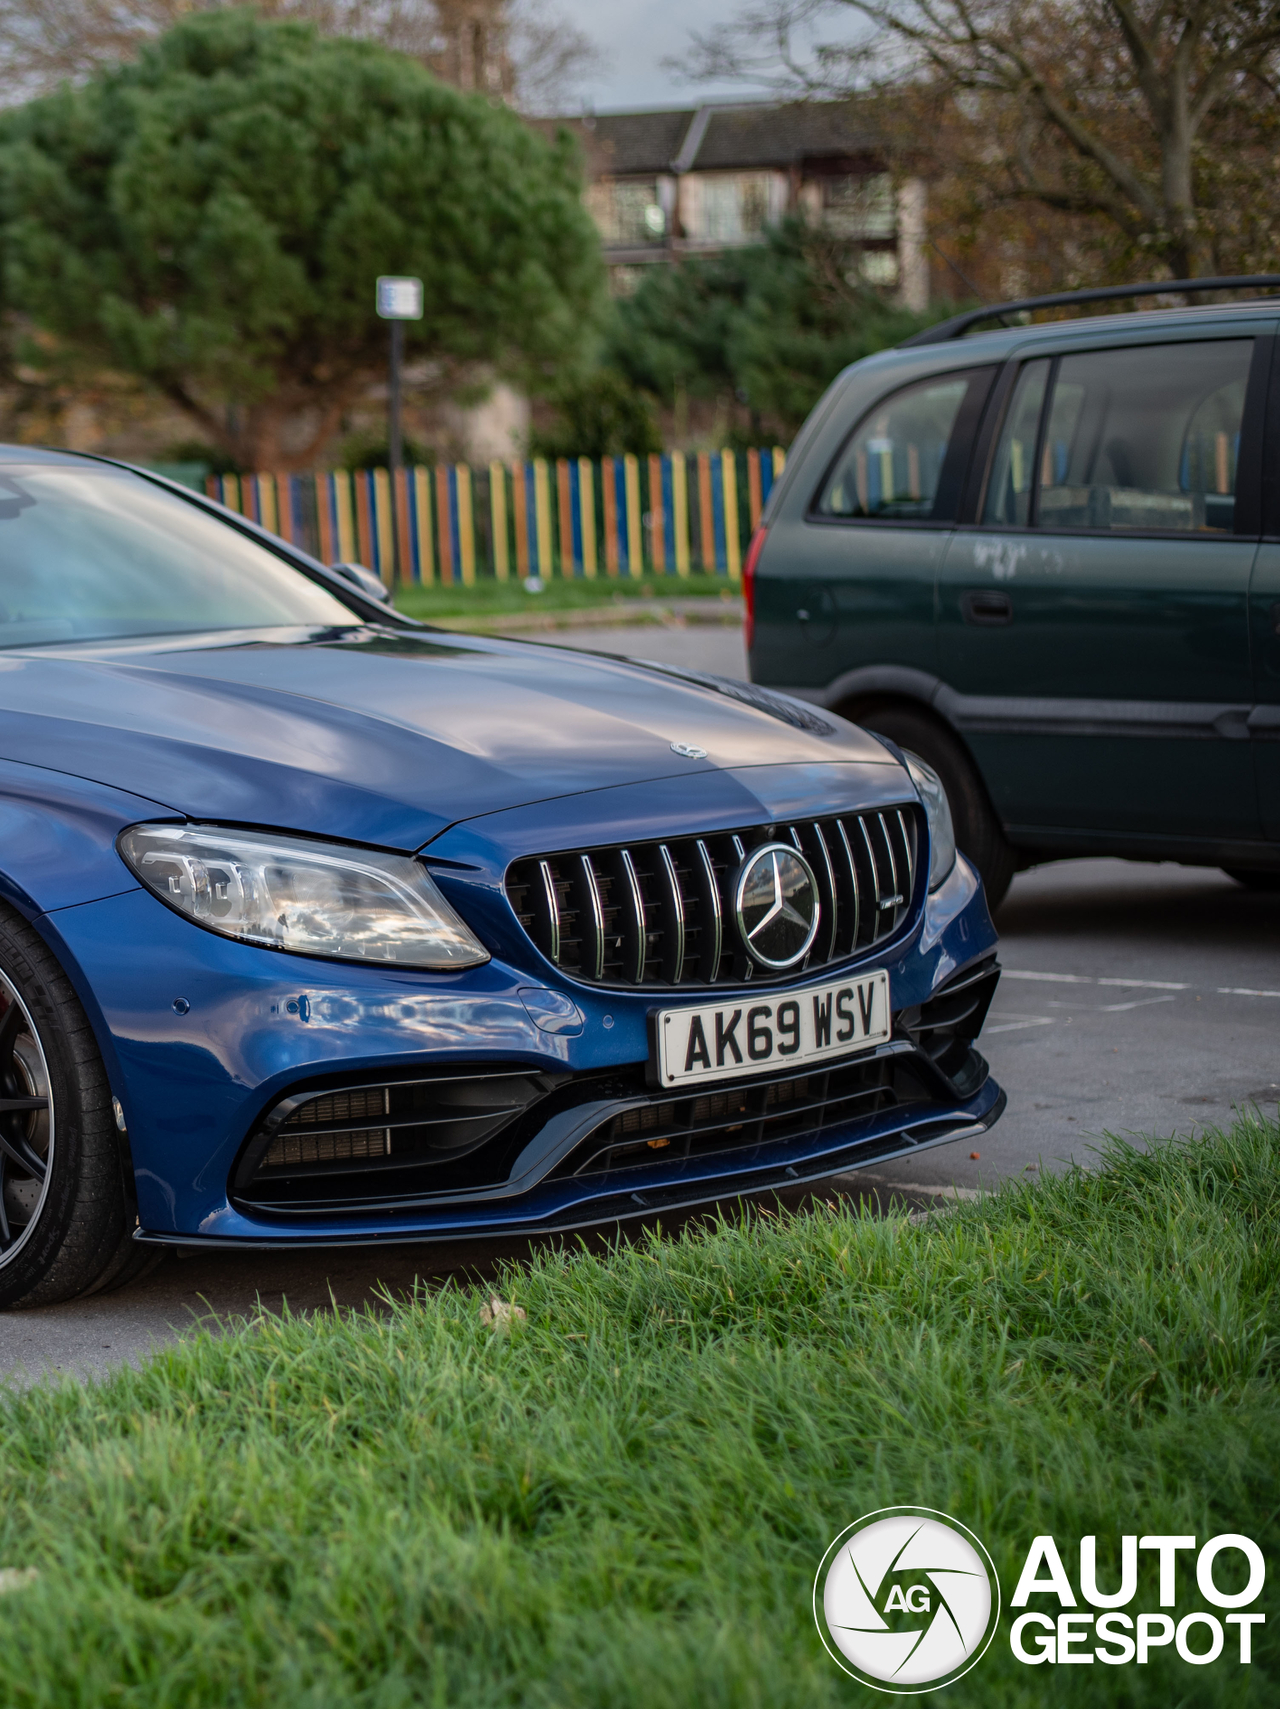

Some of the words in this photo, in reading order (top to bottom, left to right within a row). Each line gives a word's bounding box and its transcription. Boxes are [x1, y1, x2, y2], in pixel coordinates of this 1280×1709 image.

[685, 1000, 800, 1072] AK69
[812, 981, 875, 1048] WSV
[39, 1226, 62, 1266] Sport
